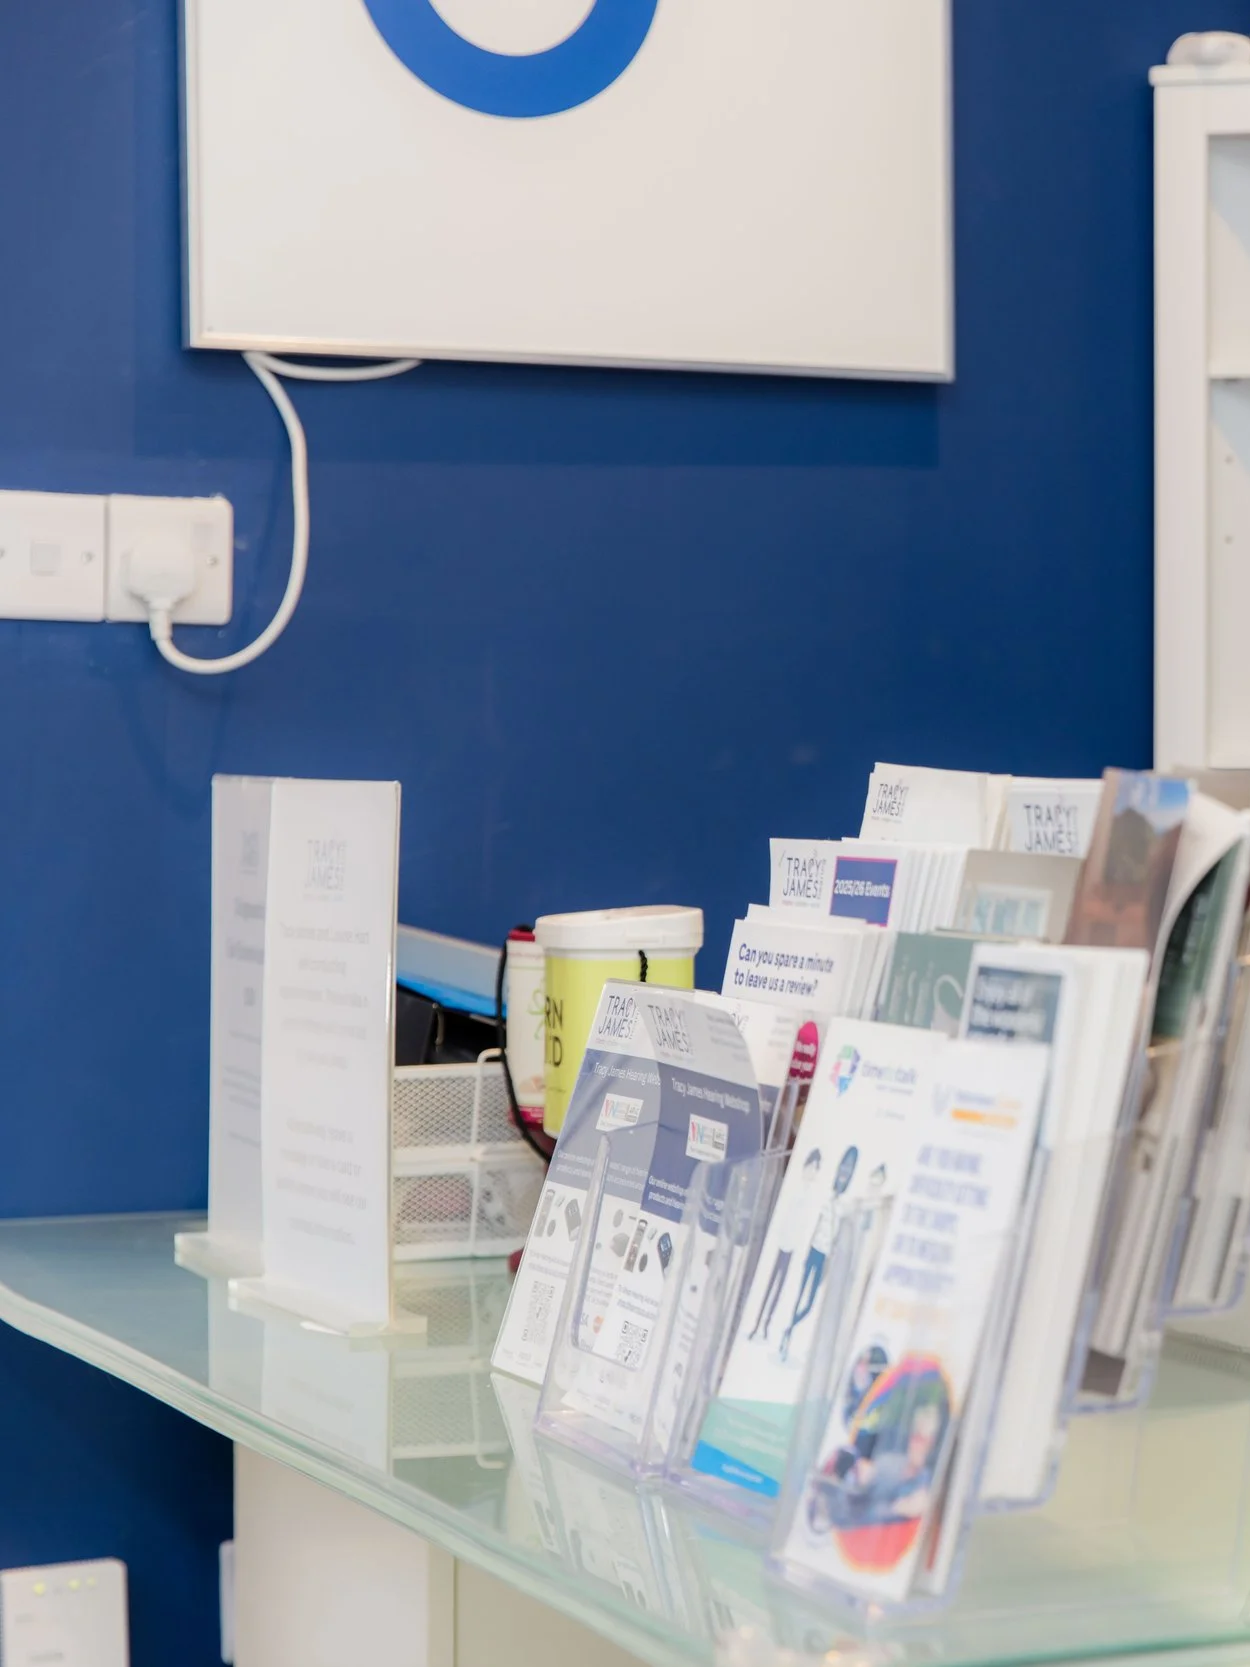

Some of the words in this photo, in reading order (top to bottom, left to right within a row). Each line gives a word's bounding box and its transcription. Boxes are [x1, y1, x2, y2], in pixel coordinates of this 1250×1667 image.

[877, 783, 905, 801] TRACY
[872, 800, 902, 817] JAMES
[1023, 804, 1071, 828] TRACY
[1025, 830, 1072, 854] JAMES
[786, 857, 821, 878] TRACY
[782, 879, 820, 899] JAMES
[738, 943, 757, 963] Can
[755, 950, 774, 968] you
[774, 952, 798, 970] spare
[798, 956, 805, 969] a
[805, 953, 834, 973] minute
[734, 968, 745, 986] to
[745, 969, 768, 989] leave
[768, 976, 780, 991] us
[779, 979, 786, 993] a
[785, 976, 819, 996] review?
[606, 995, 637, 1020] TRACY
[648, 1005, 685, 1030] TRACY
[598, 1016, 634, 1039] JAMES
[656, 1028, 691, 1053] JAMES
[594, 1062, 609, 1079] Tracy
[608, 1065, 627, 1081] James
[627, 1068, 647, 1086] Hearing
[671, 1077, 687, 1097] Tracy
[686, 1082, 704, 1099] James
